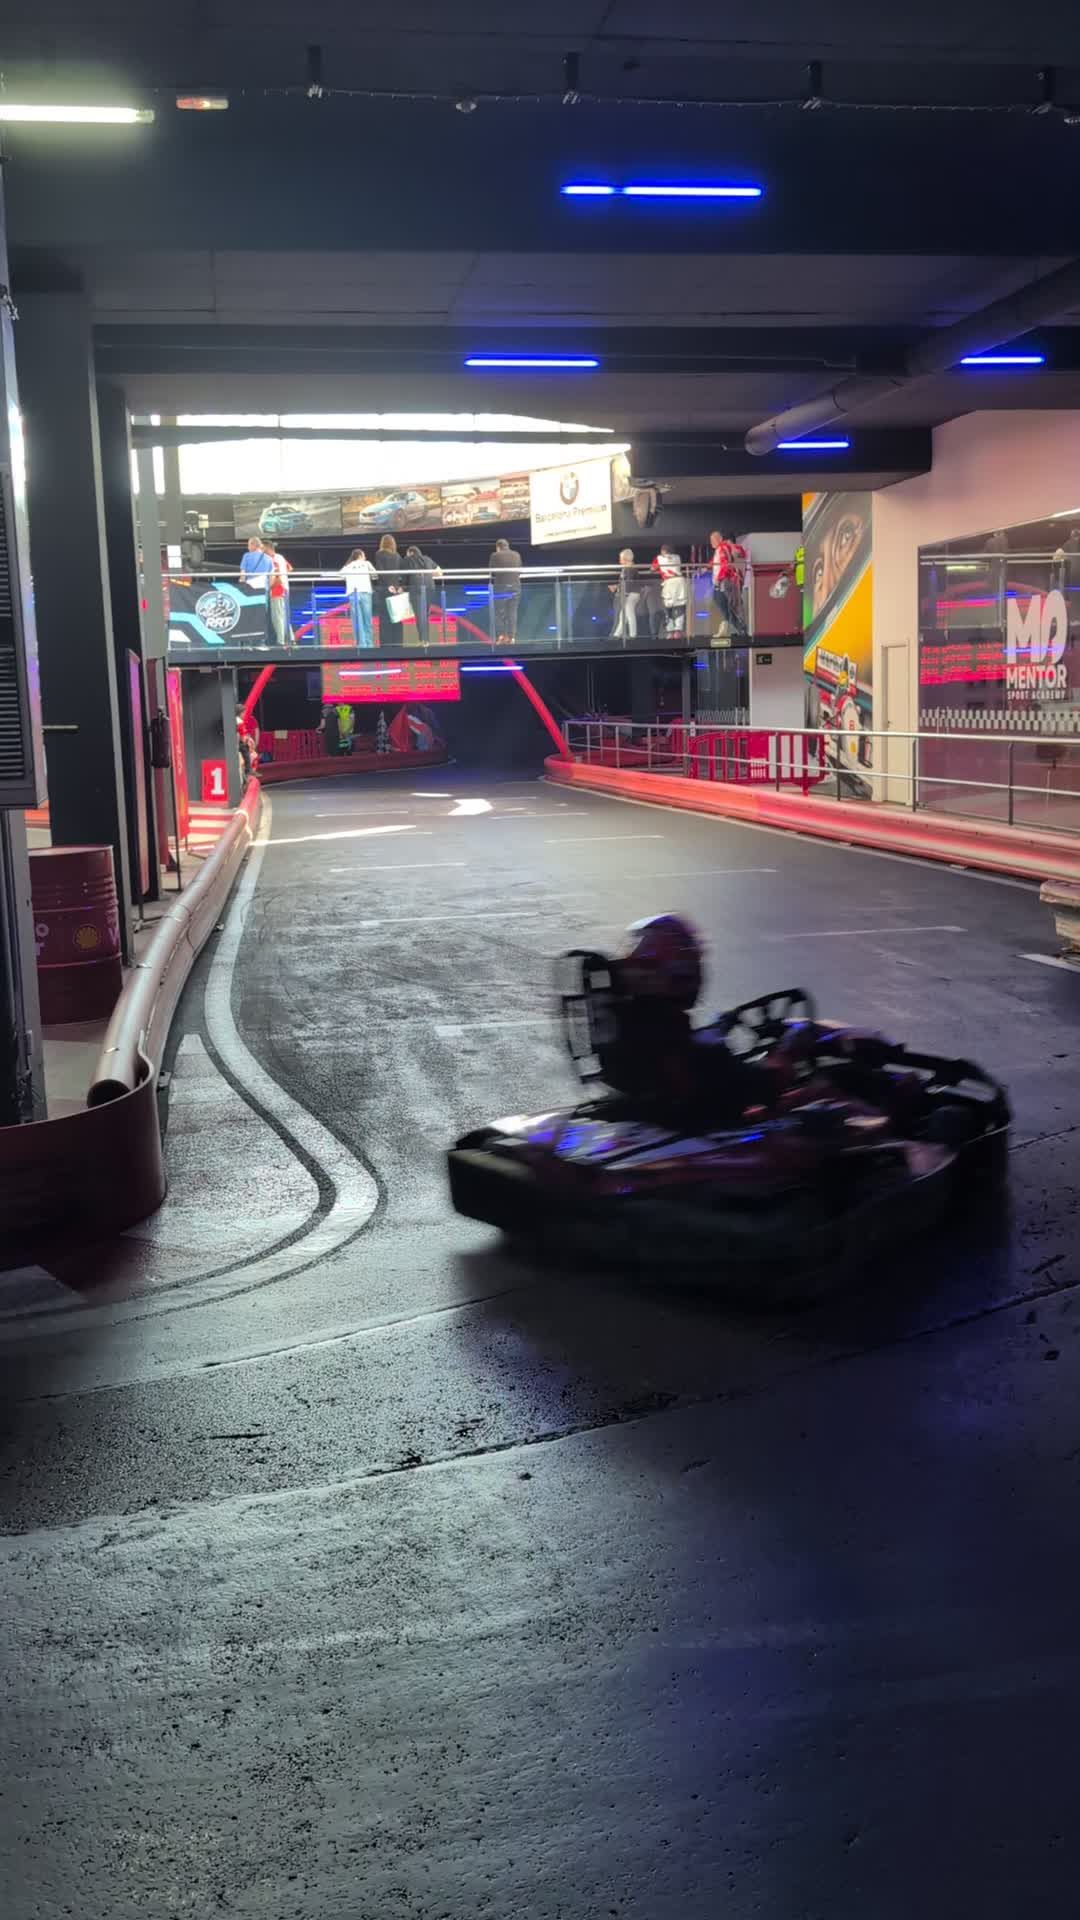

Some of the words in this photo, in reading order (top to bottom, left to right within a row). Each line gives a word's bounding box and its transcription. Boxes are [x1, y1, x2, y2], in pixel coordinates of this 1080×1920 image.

[1006, 664, 1067, 689] MENTOR
[1007, 690, 1029, 700] SPORT
[1031, 690, 1066, 700] ACADEMY
[211, 767, 225, 795] 1
